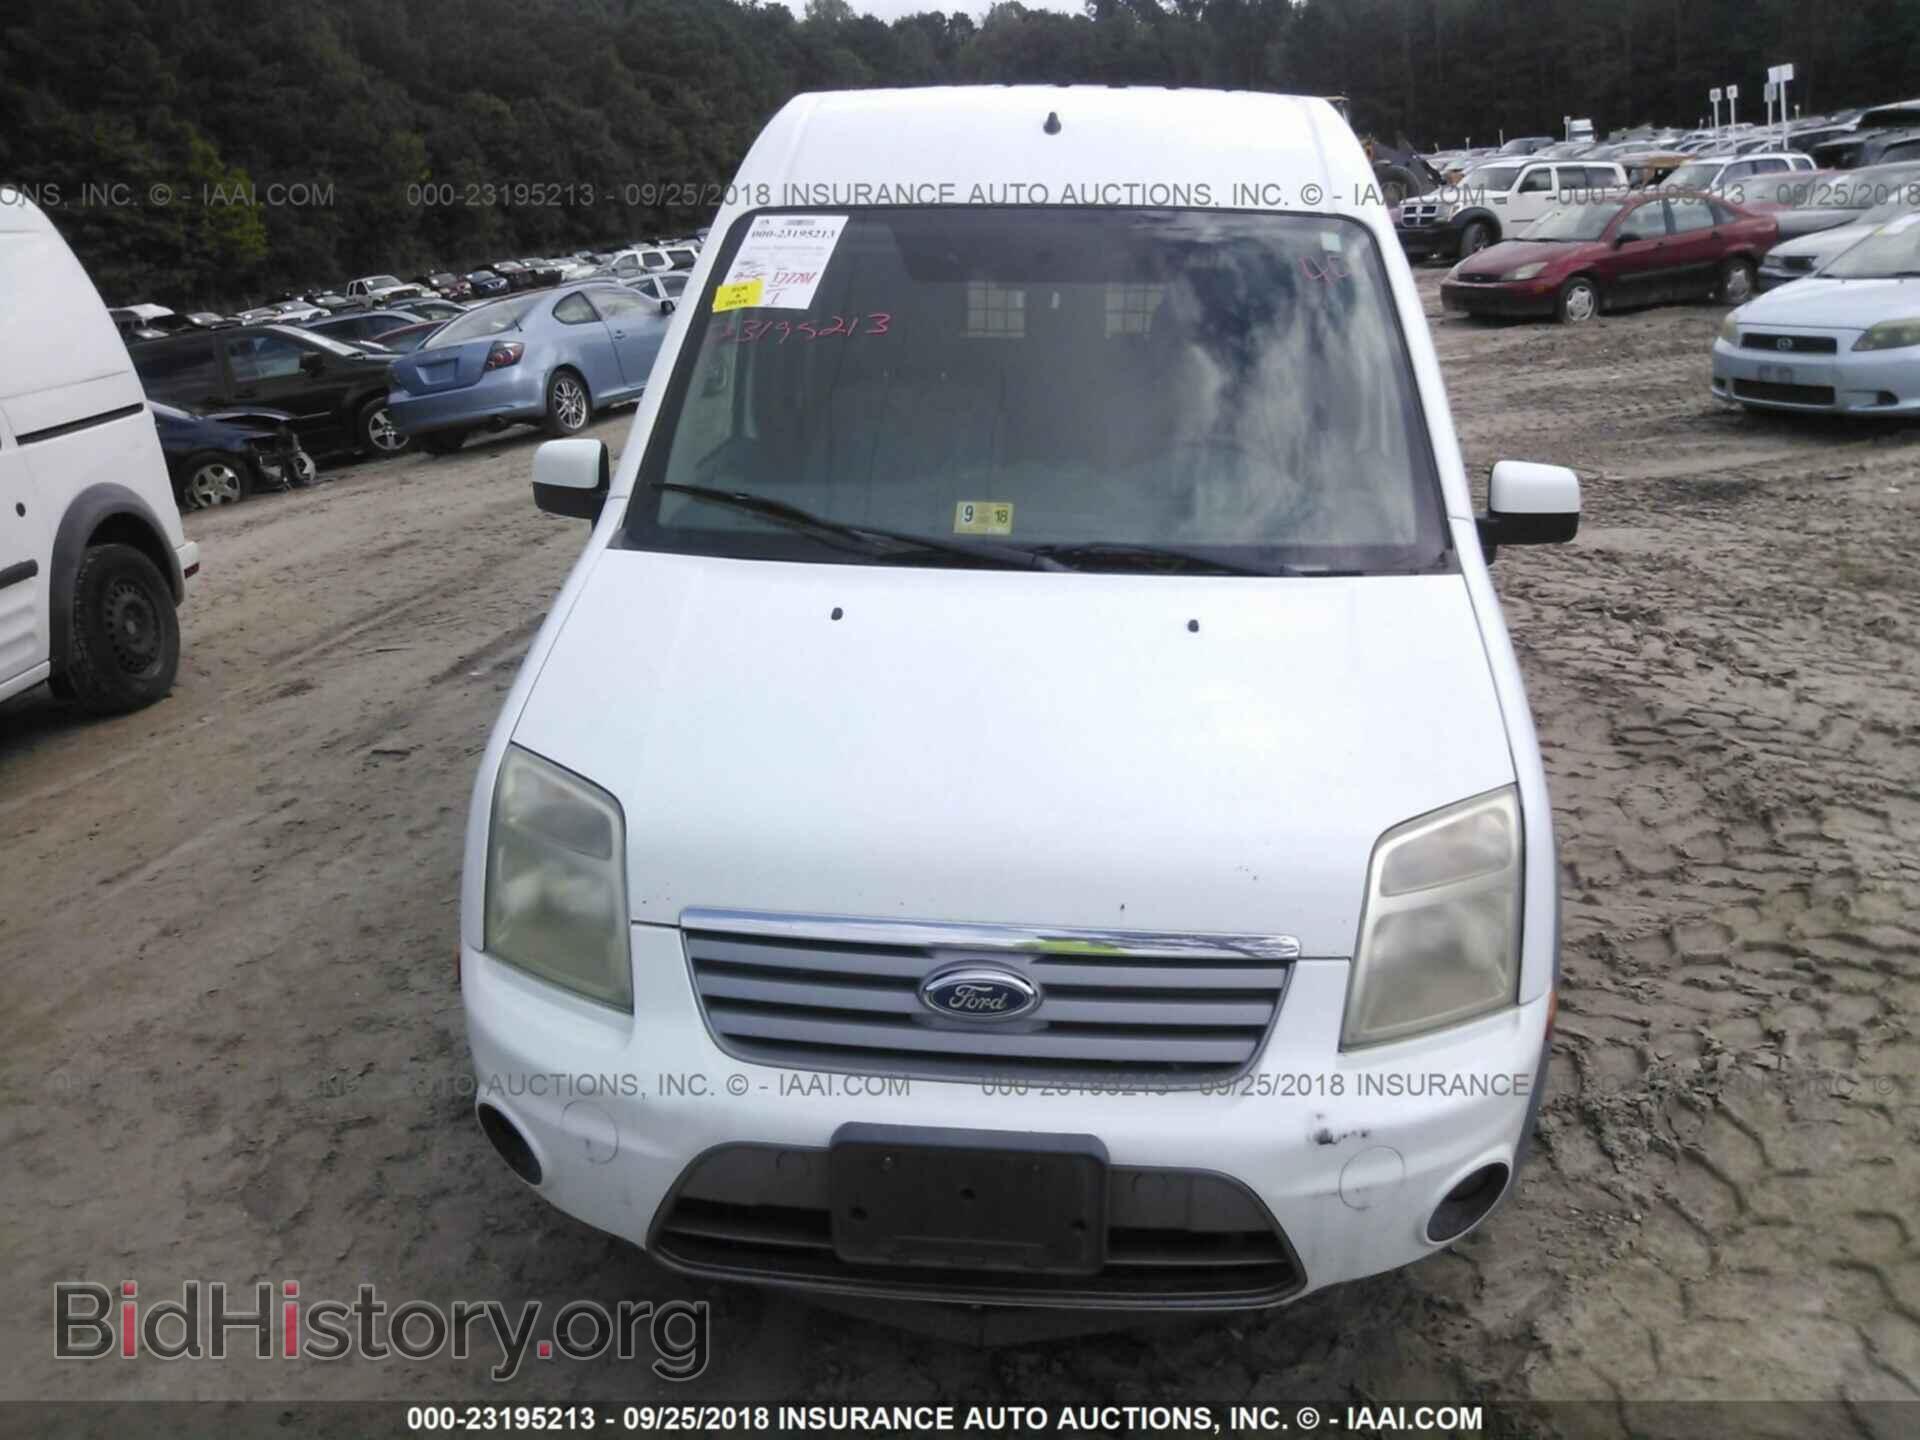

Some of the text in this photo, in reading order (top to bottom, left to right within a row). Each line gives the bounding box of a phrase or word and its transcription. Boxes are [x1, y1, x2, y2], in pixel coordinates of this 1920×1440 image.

[964, 504, 975, 523] 9
[994, 509, 1009, 524] 18
[948, 984, 1008, 1010] Ford
